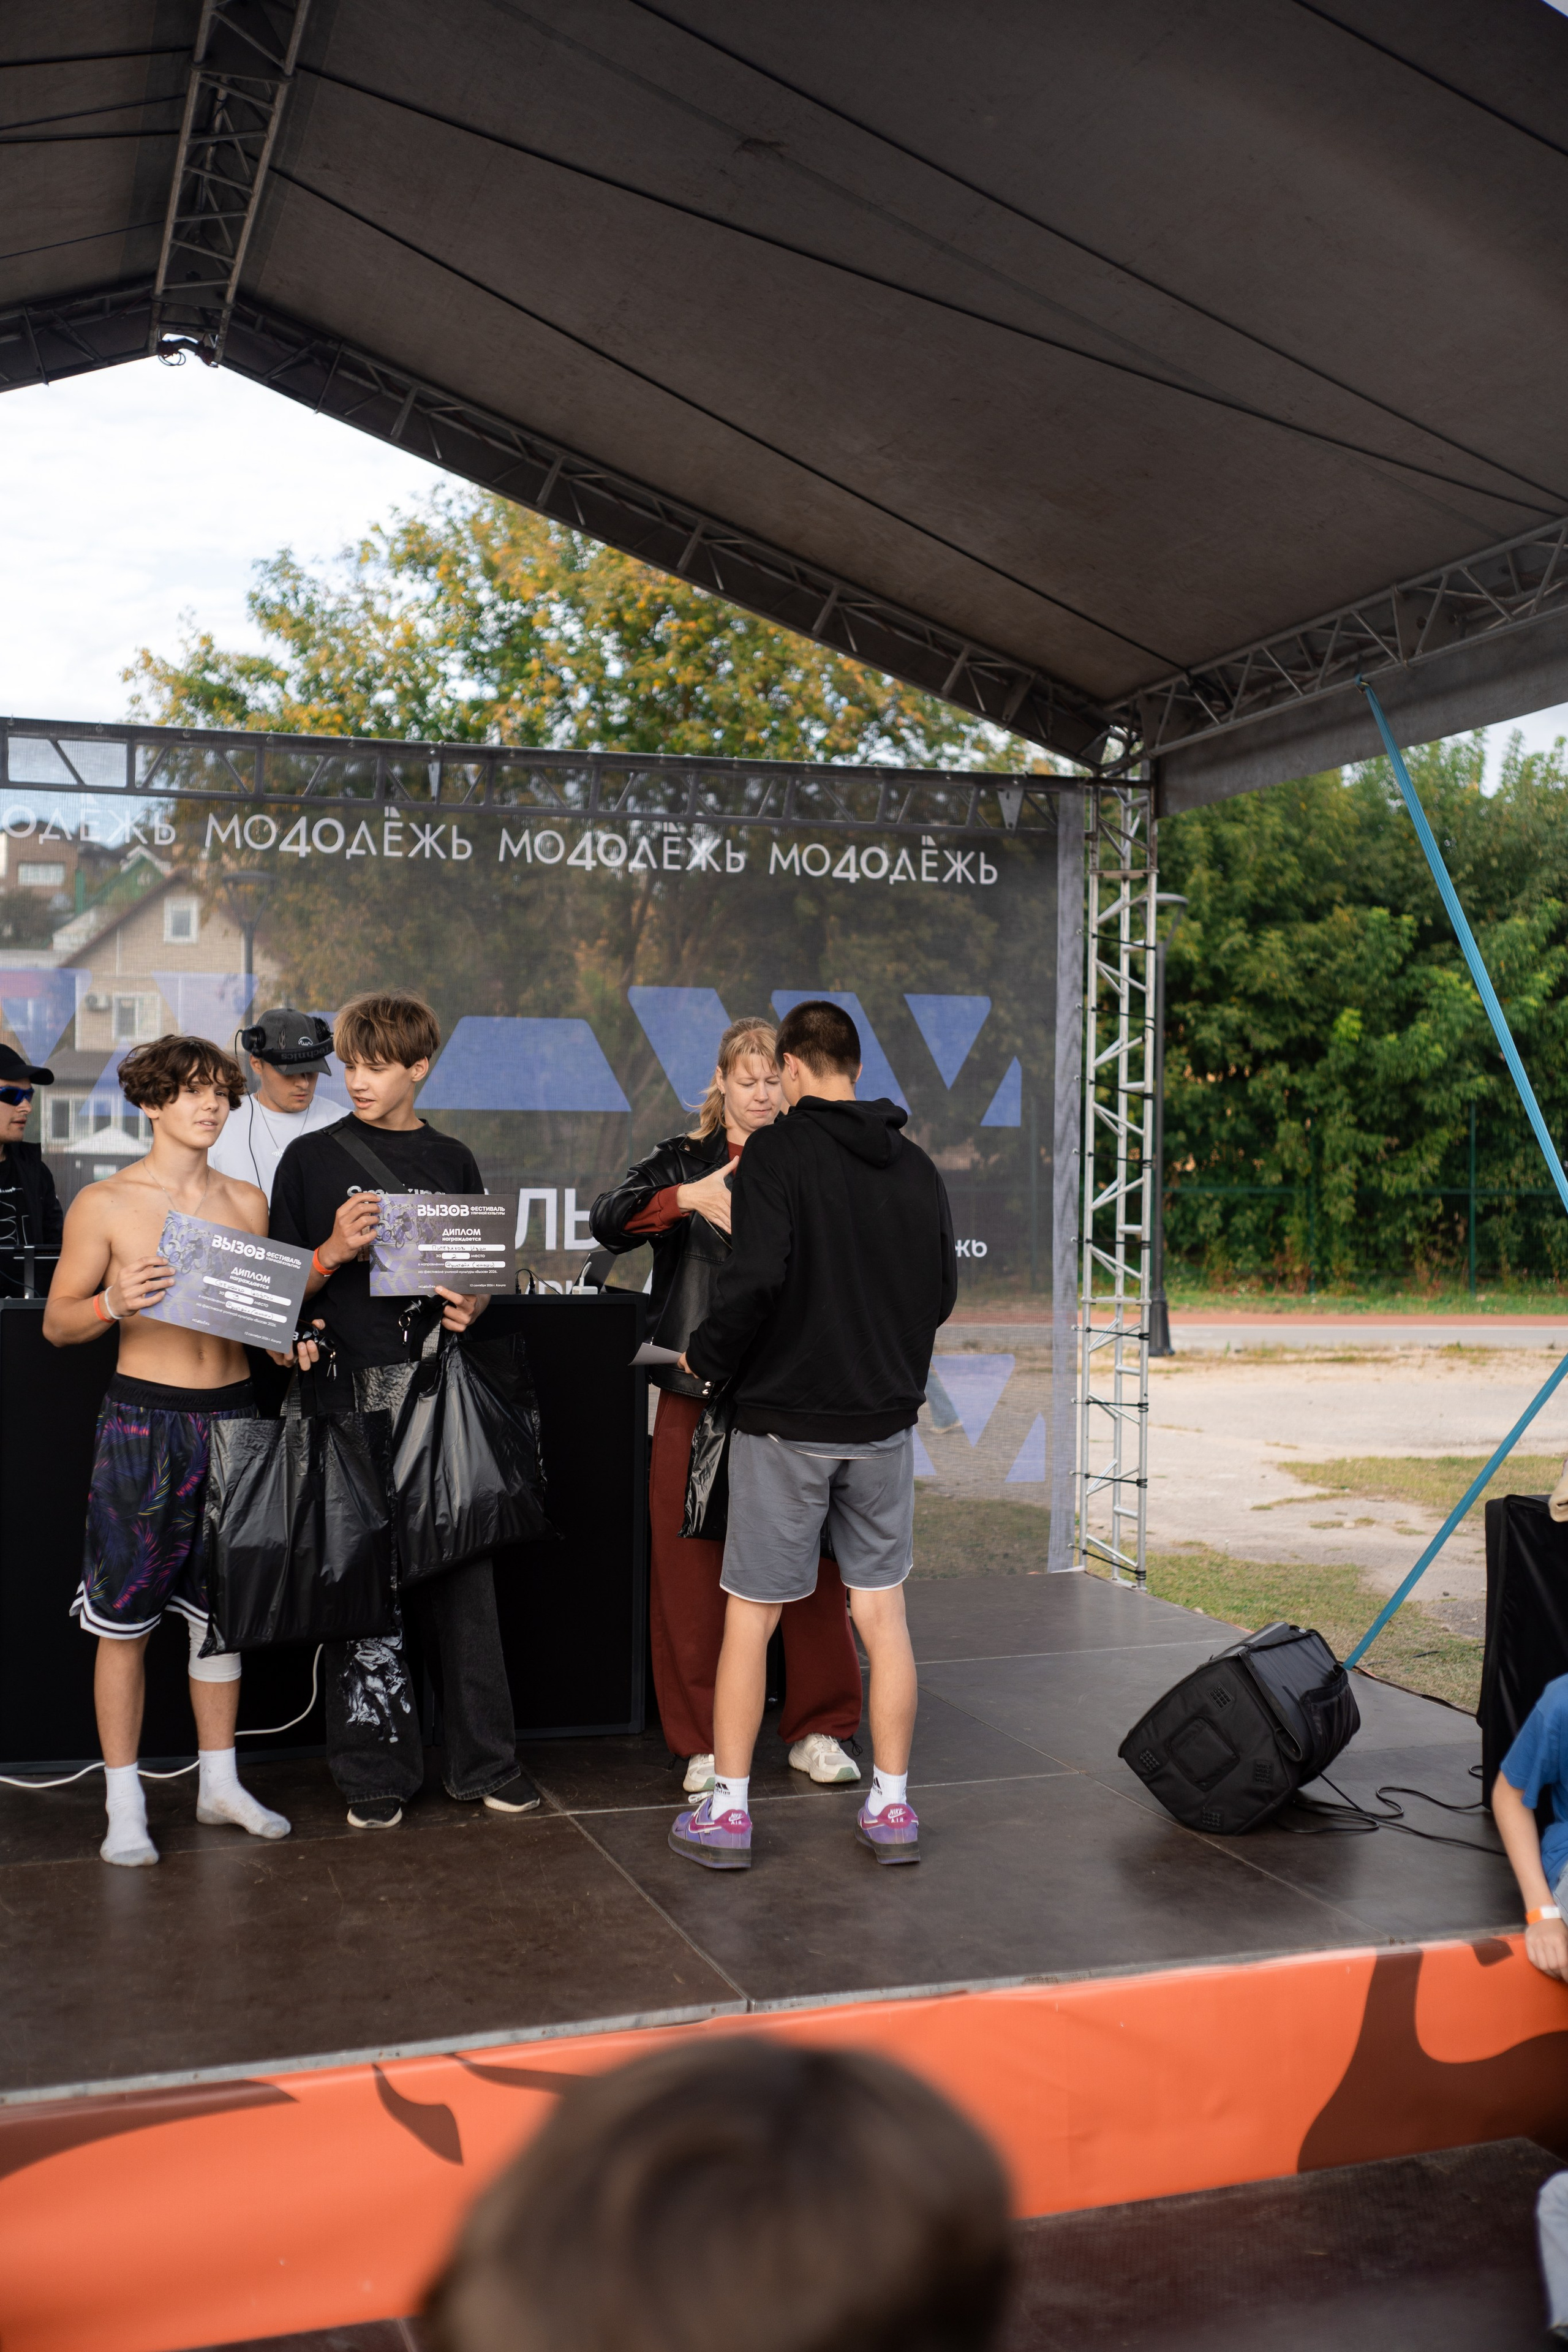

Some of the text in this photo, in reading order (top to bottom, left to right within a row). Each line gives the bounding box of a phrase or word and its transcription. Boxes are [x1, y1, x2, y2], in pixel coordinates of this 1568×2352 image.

[281, 1046, 331, 1061] Technics
[417, 1204, 470, 1216] ВЫЗОВ
[211, 1234, 301, 1265] ВЫЗОВ ФЕСТИВАЛЬ
[229, 1275, 270, 1290] награждается
[231, 1267, 271, 1284] ДИПЛОМ
